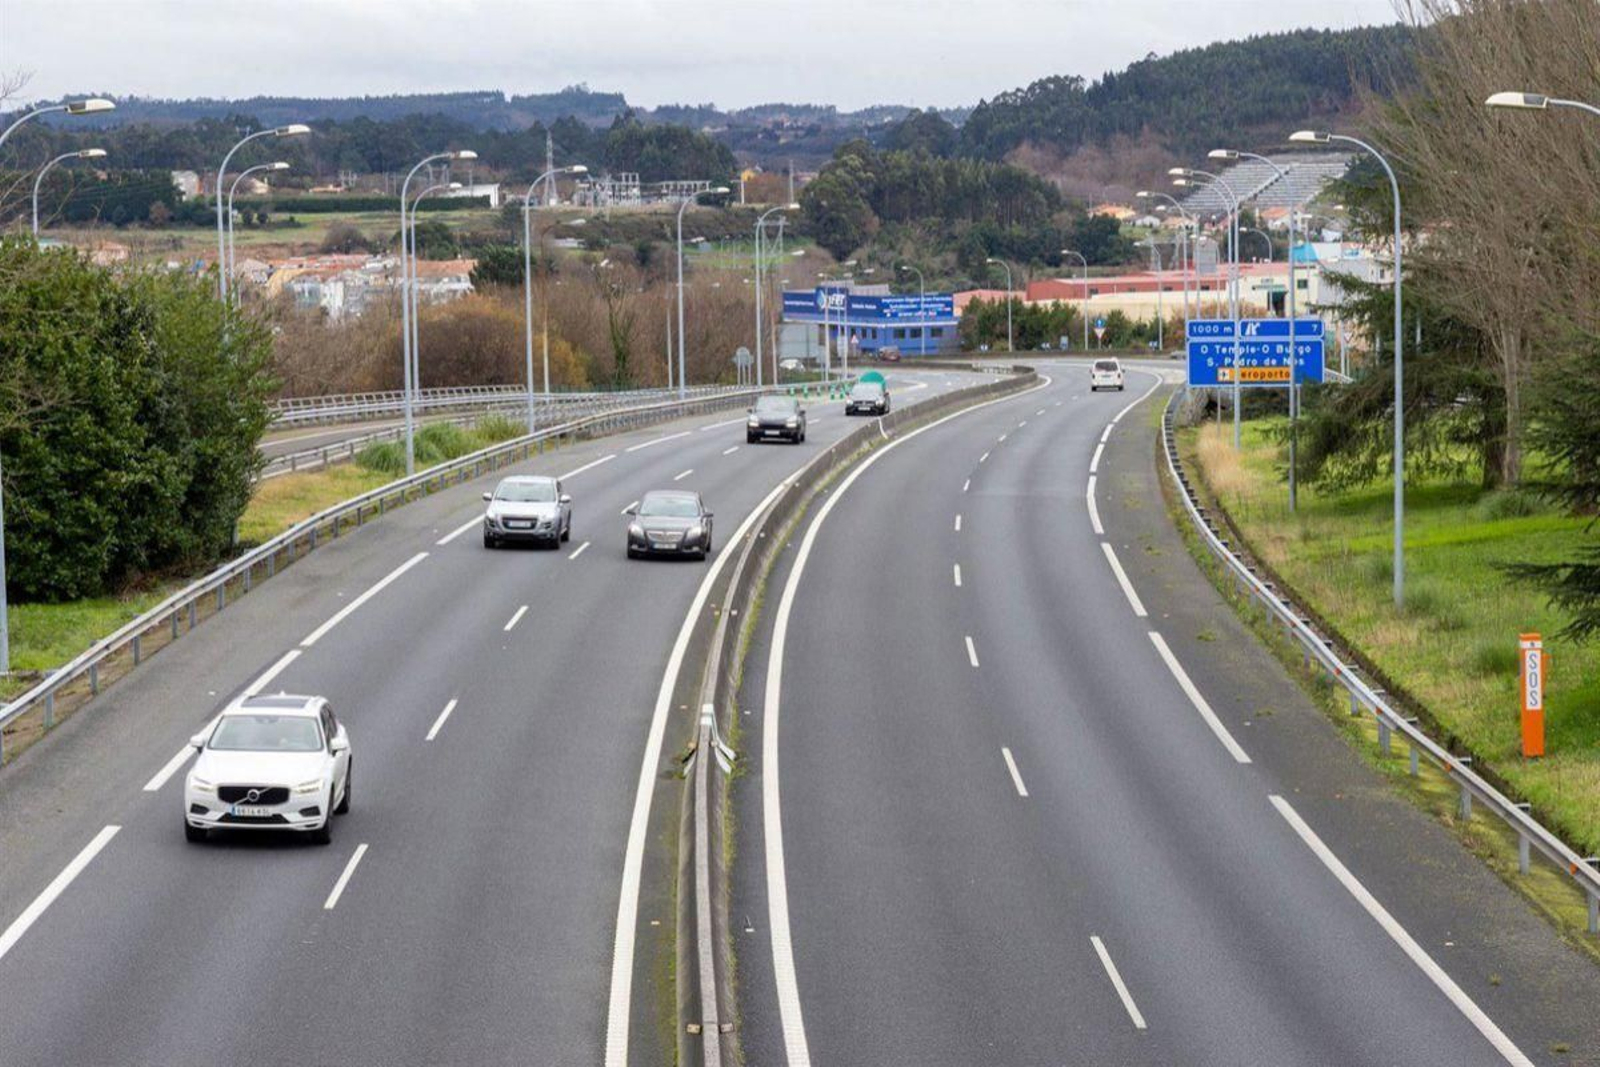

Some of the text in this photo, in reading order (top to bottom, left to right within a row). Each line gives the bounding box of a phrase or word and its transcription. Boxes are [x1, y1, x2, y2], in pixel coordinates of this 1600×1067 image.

[1193, 324, 1233, 334] 1000 m
[1200, 345, 1208, 354] O
[1263, 357, 1277, 366] de
[1239, 369, 1291, 380] eroporto
[1529, 653, 1538, 706] SOS
